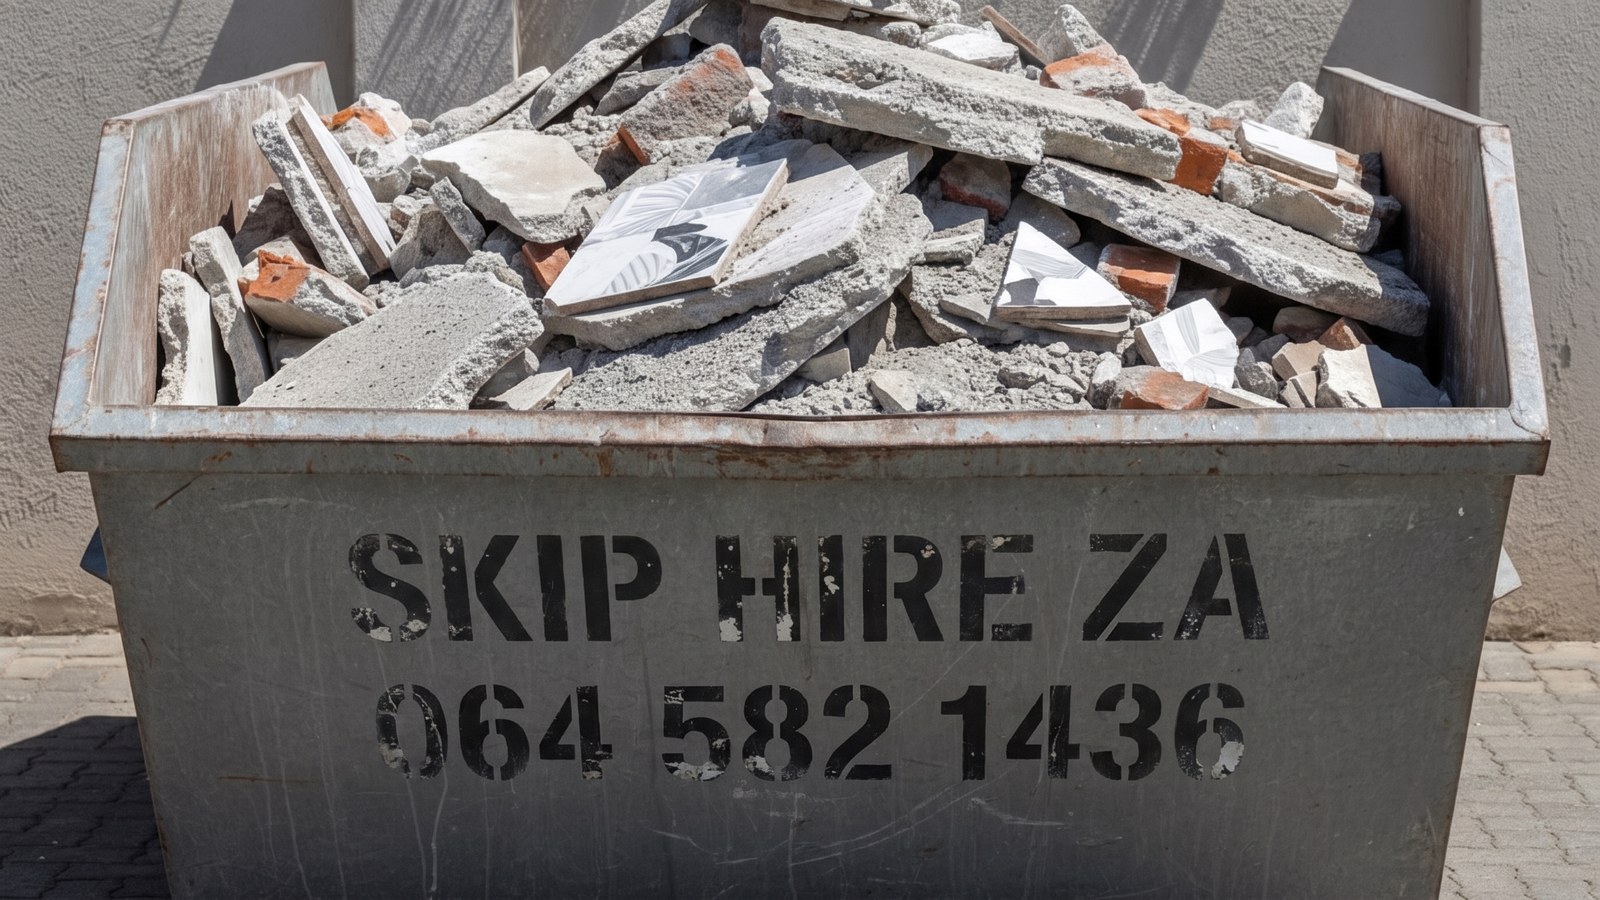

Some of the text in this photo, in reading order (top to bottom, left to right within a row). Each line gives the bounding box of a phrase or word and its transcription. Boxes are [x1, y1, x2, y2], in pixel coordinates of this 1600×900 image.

[348, 533, 1269, 641] SKIP HIRE ZA
[376, 683, 1245, 781] 064 582 1436
